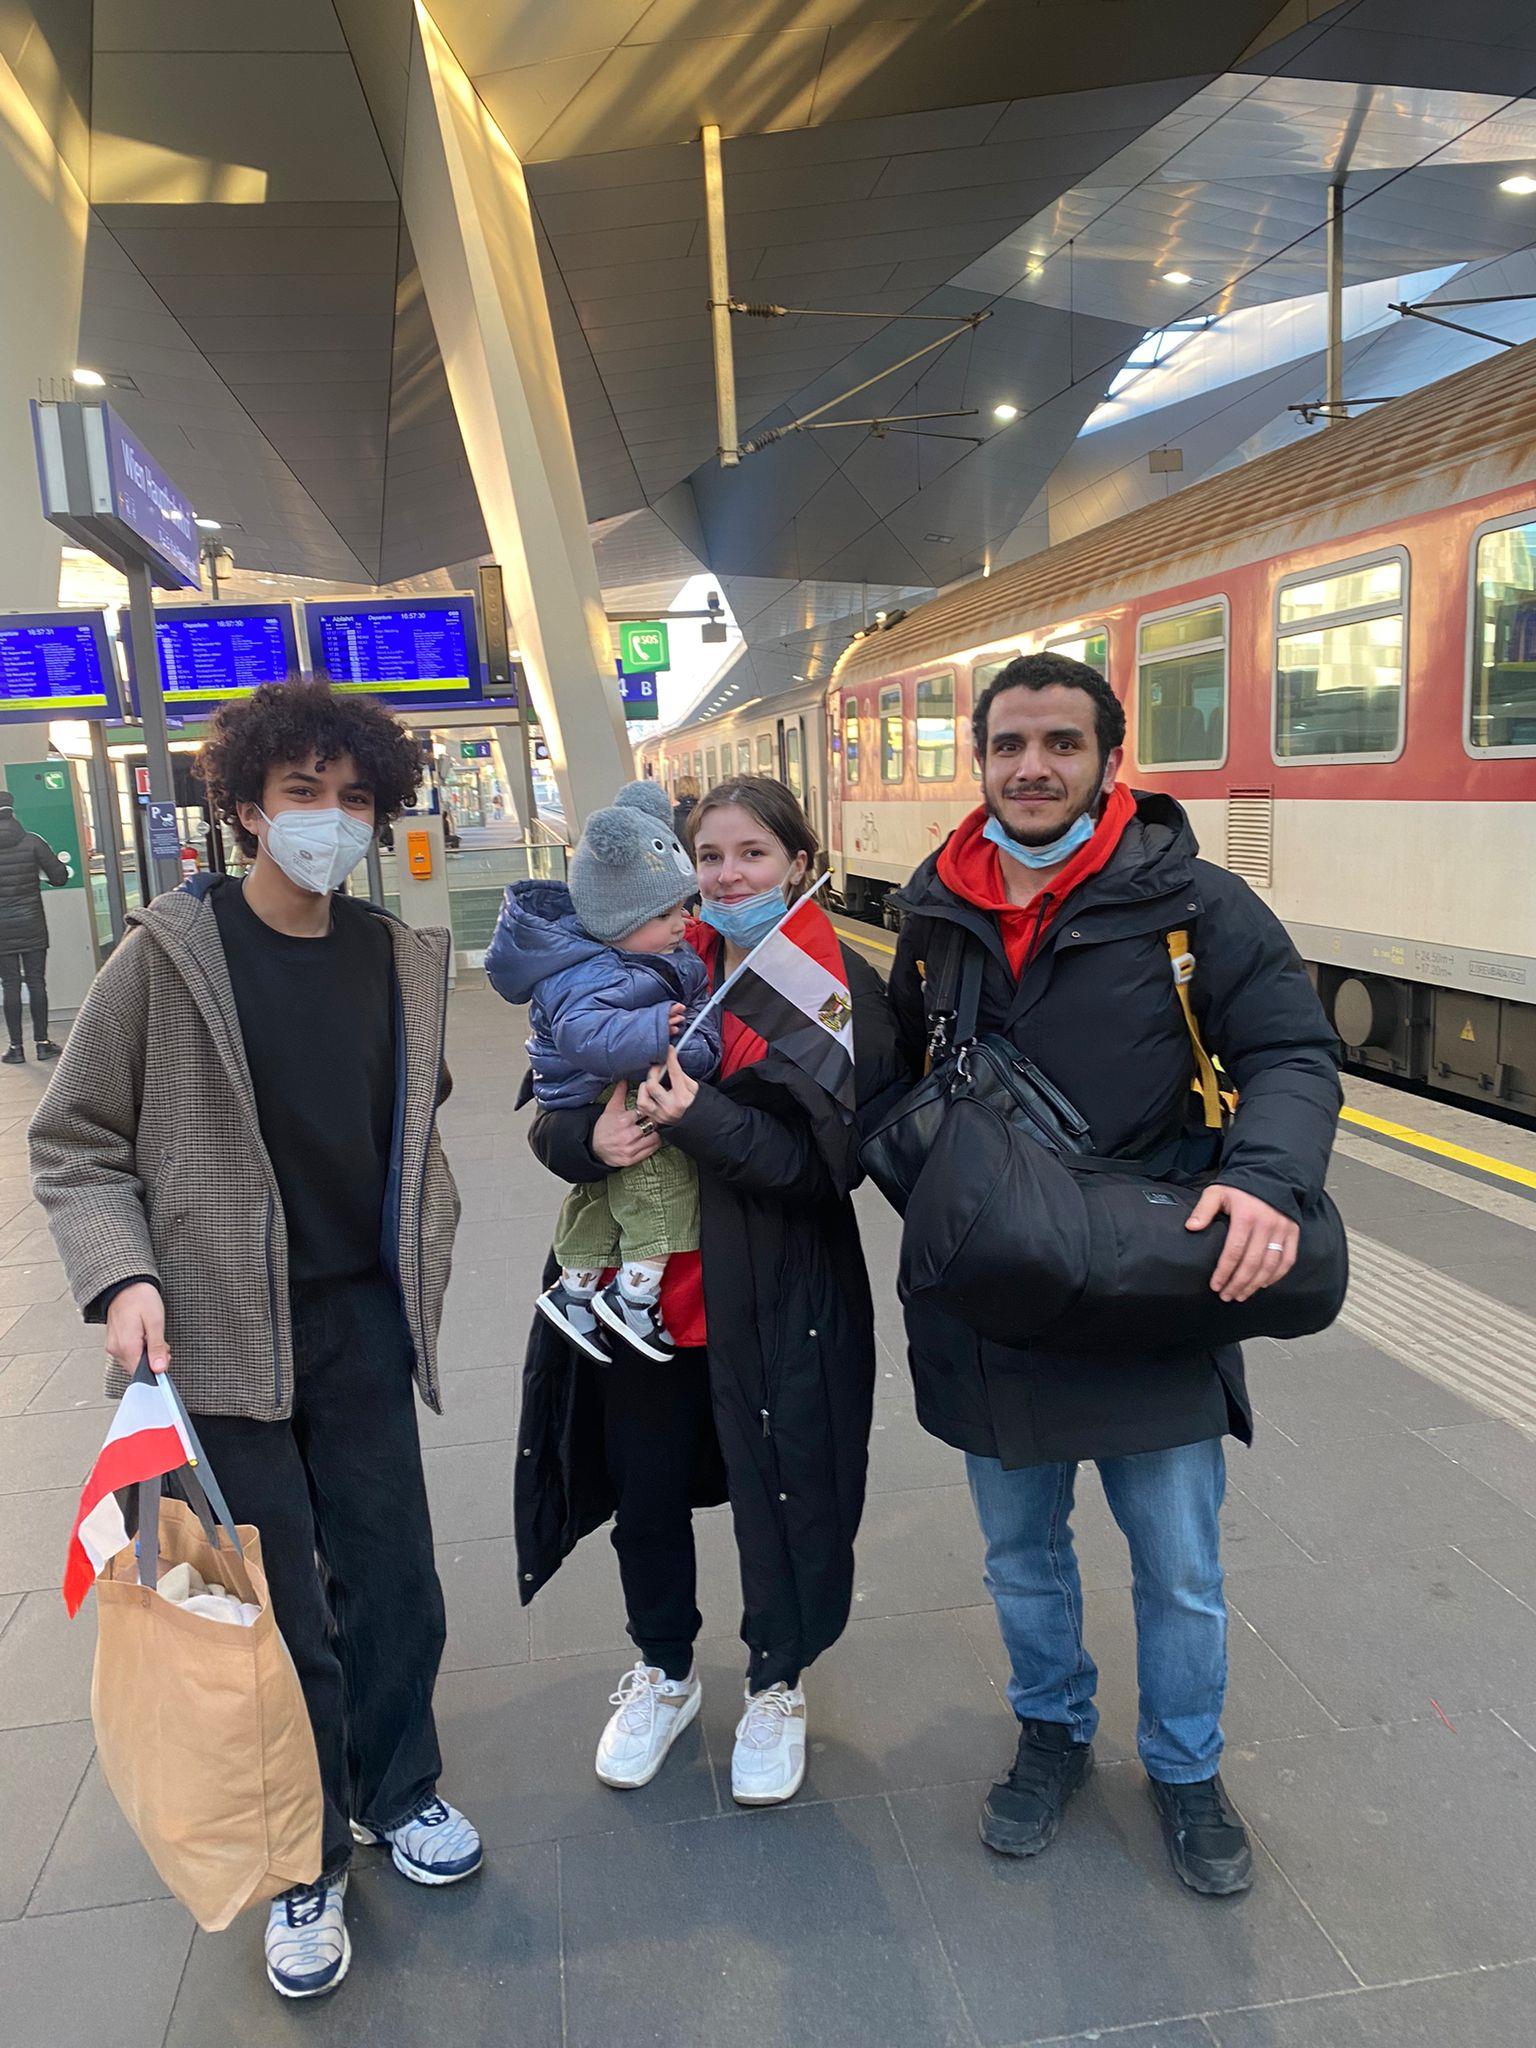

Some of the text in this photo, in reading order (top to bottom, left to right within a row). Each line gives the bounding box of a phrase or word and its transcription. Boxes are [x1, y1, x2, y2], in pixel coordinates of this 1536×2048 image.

[640, 634, 659, 645] SOS
[640, 680, 653, 697] B
[151, 806, 161, 819] P
